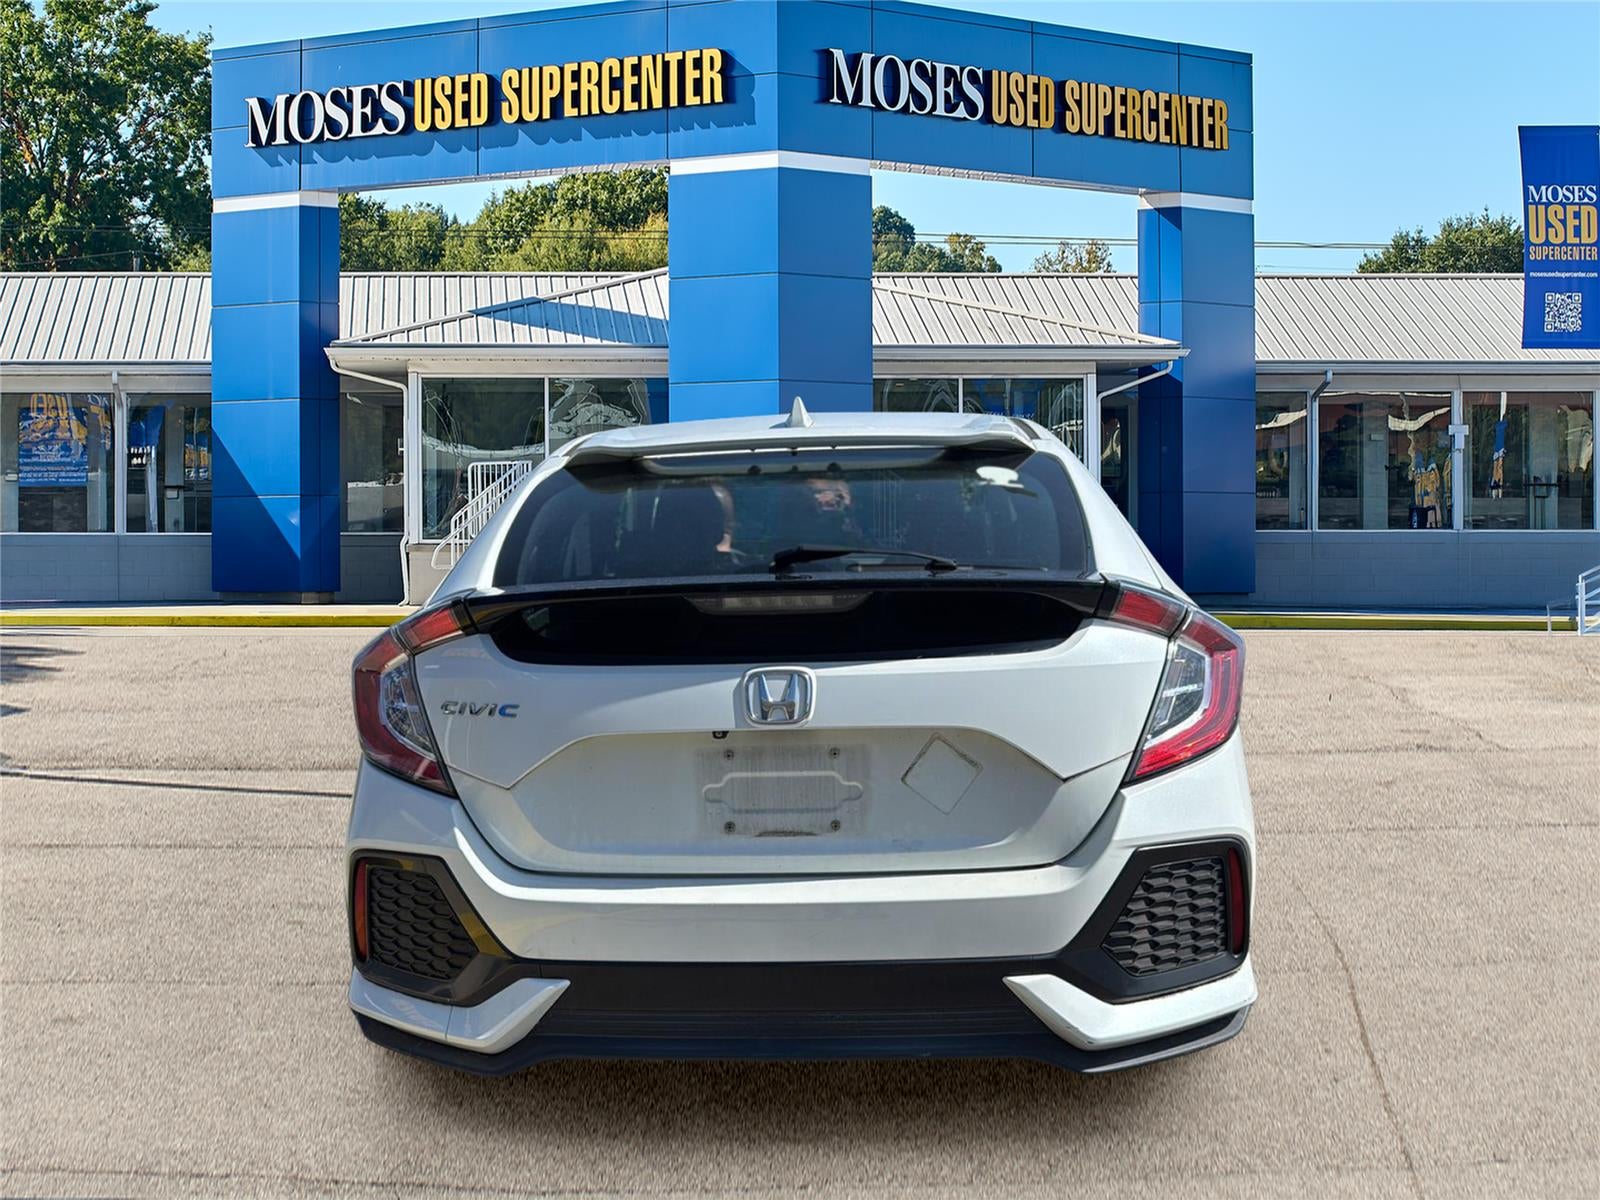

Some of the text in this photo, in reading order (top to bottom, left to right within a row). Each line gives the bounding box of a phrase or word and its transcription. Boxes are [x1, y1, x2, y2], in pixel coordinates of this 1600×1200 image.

[244, 47, 725, 148] MOSES USED SUPERCENTER
[828, 47, 1230, 151] MOSES USED SUPERCENTER
[1528, 185, 1597, 203] MOSES
[1528, 205, 1598, 244] USED
[1529, 246, 1598, 260] SUPERCENTER
[440, 700, 520, 719] CIVIC
